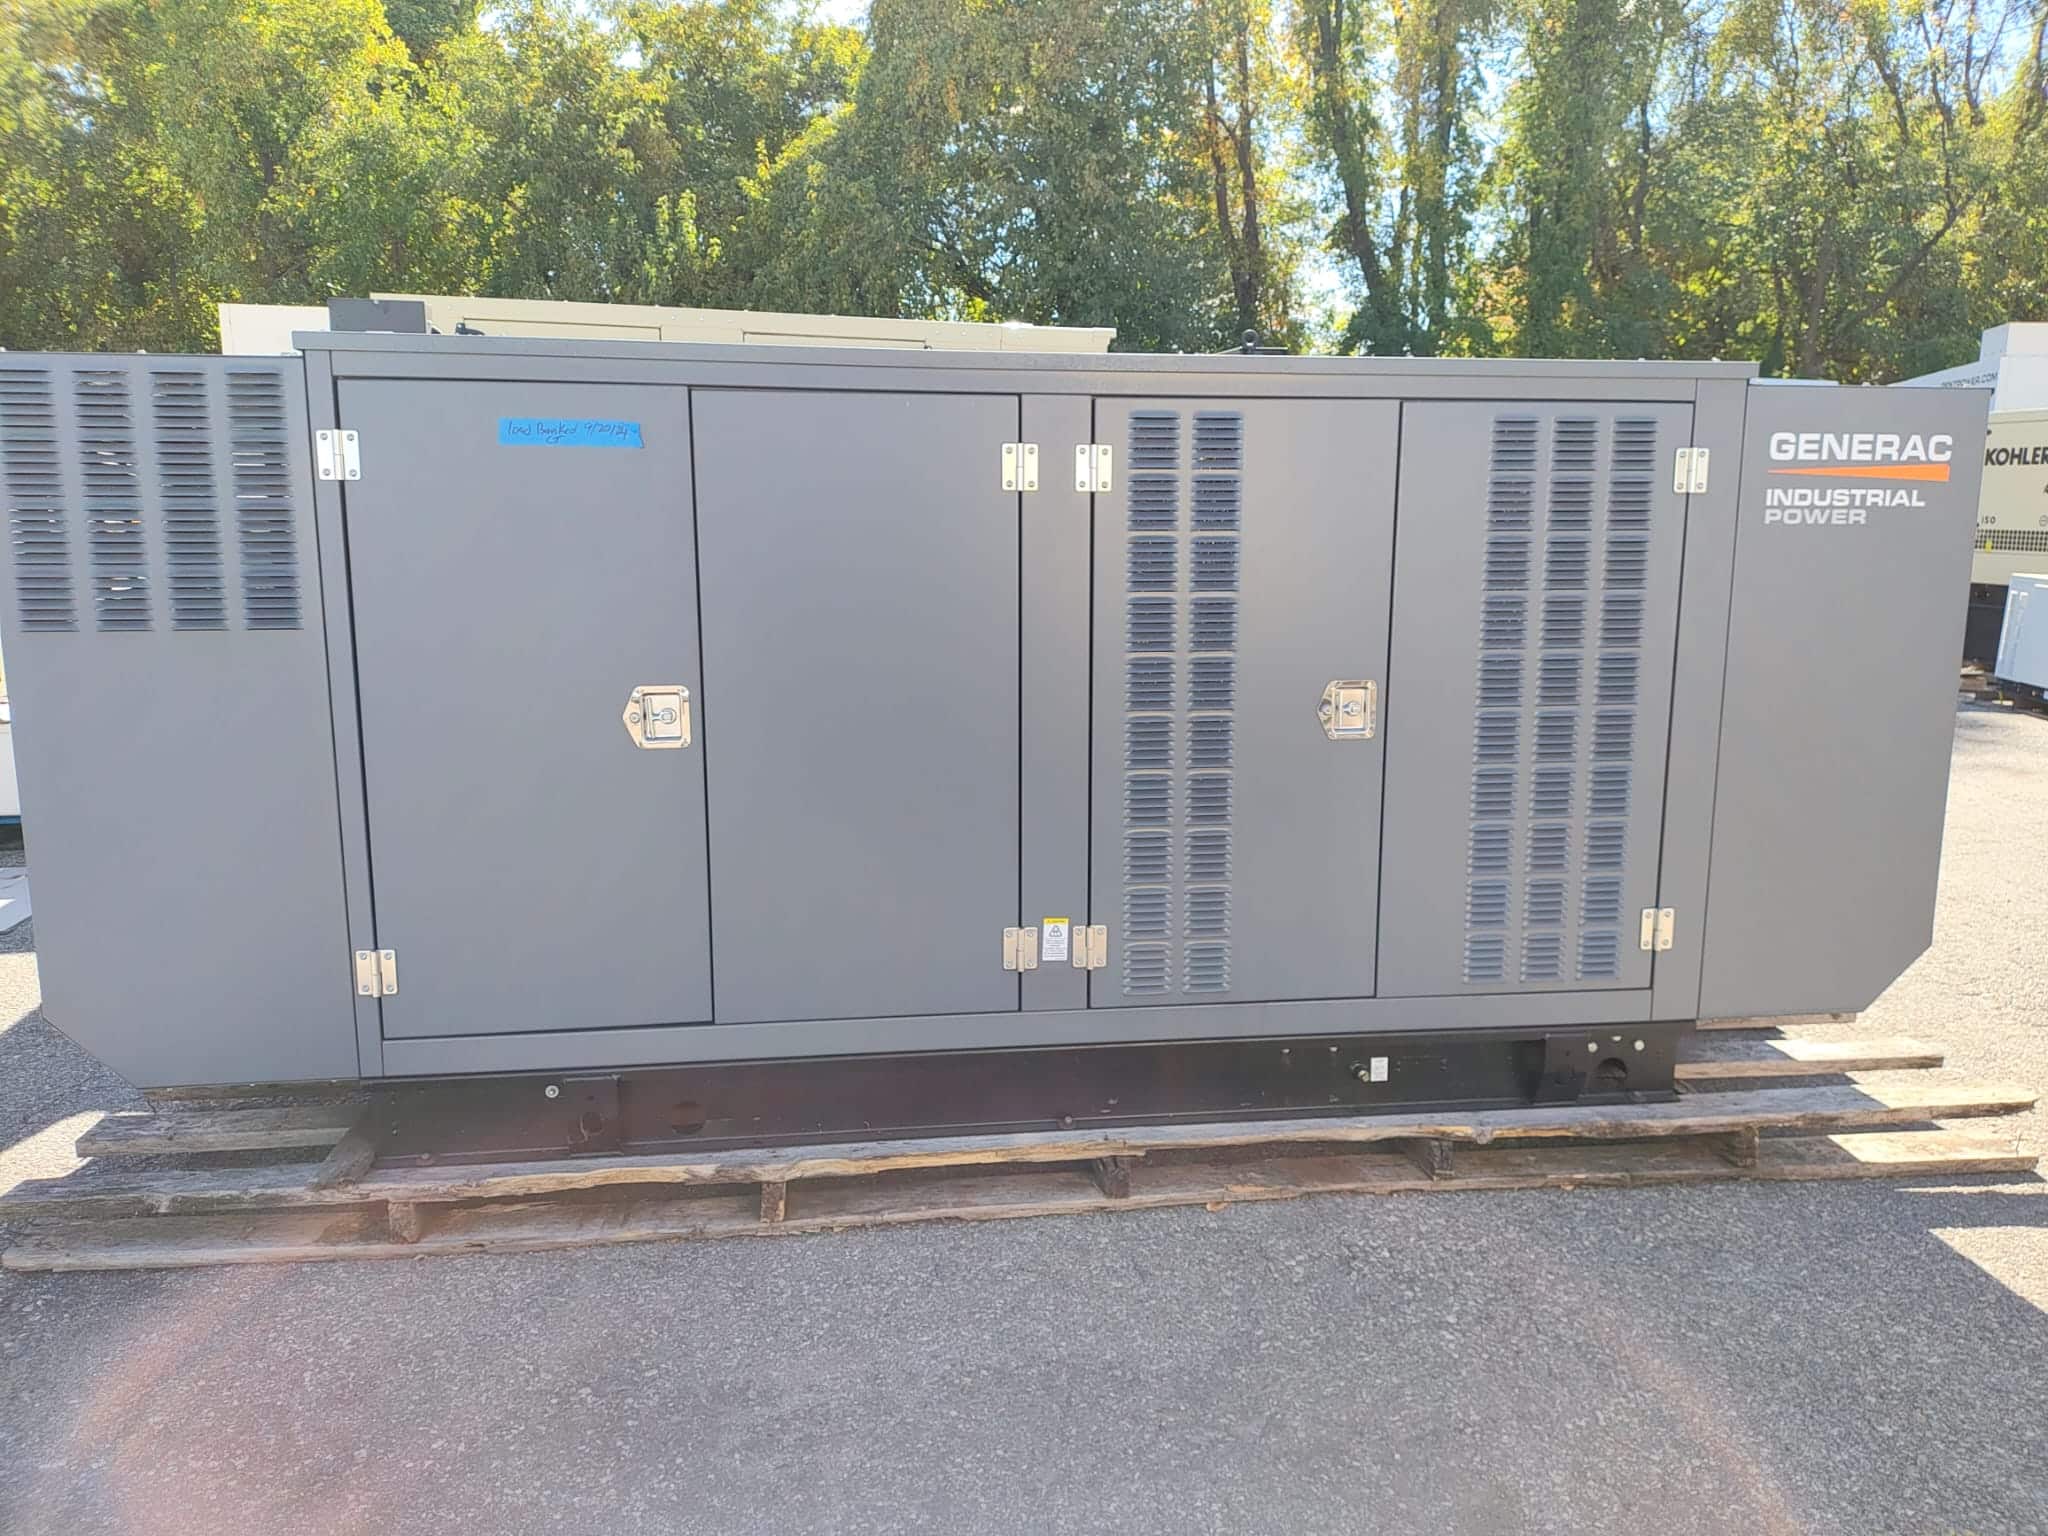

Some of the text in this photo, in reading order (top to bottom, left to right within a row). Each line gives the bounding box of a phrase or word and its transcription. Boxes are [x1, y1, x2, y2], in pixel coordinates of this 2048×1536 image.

[1769, 432, 1953, 461] GENERAC
[1984, 447, 2048, 466] KOHLER
[1765, 488, 1926, 507] INDUSTRIAL
[1764, 508, 1867, 525] POWER
